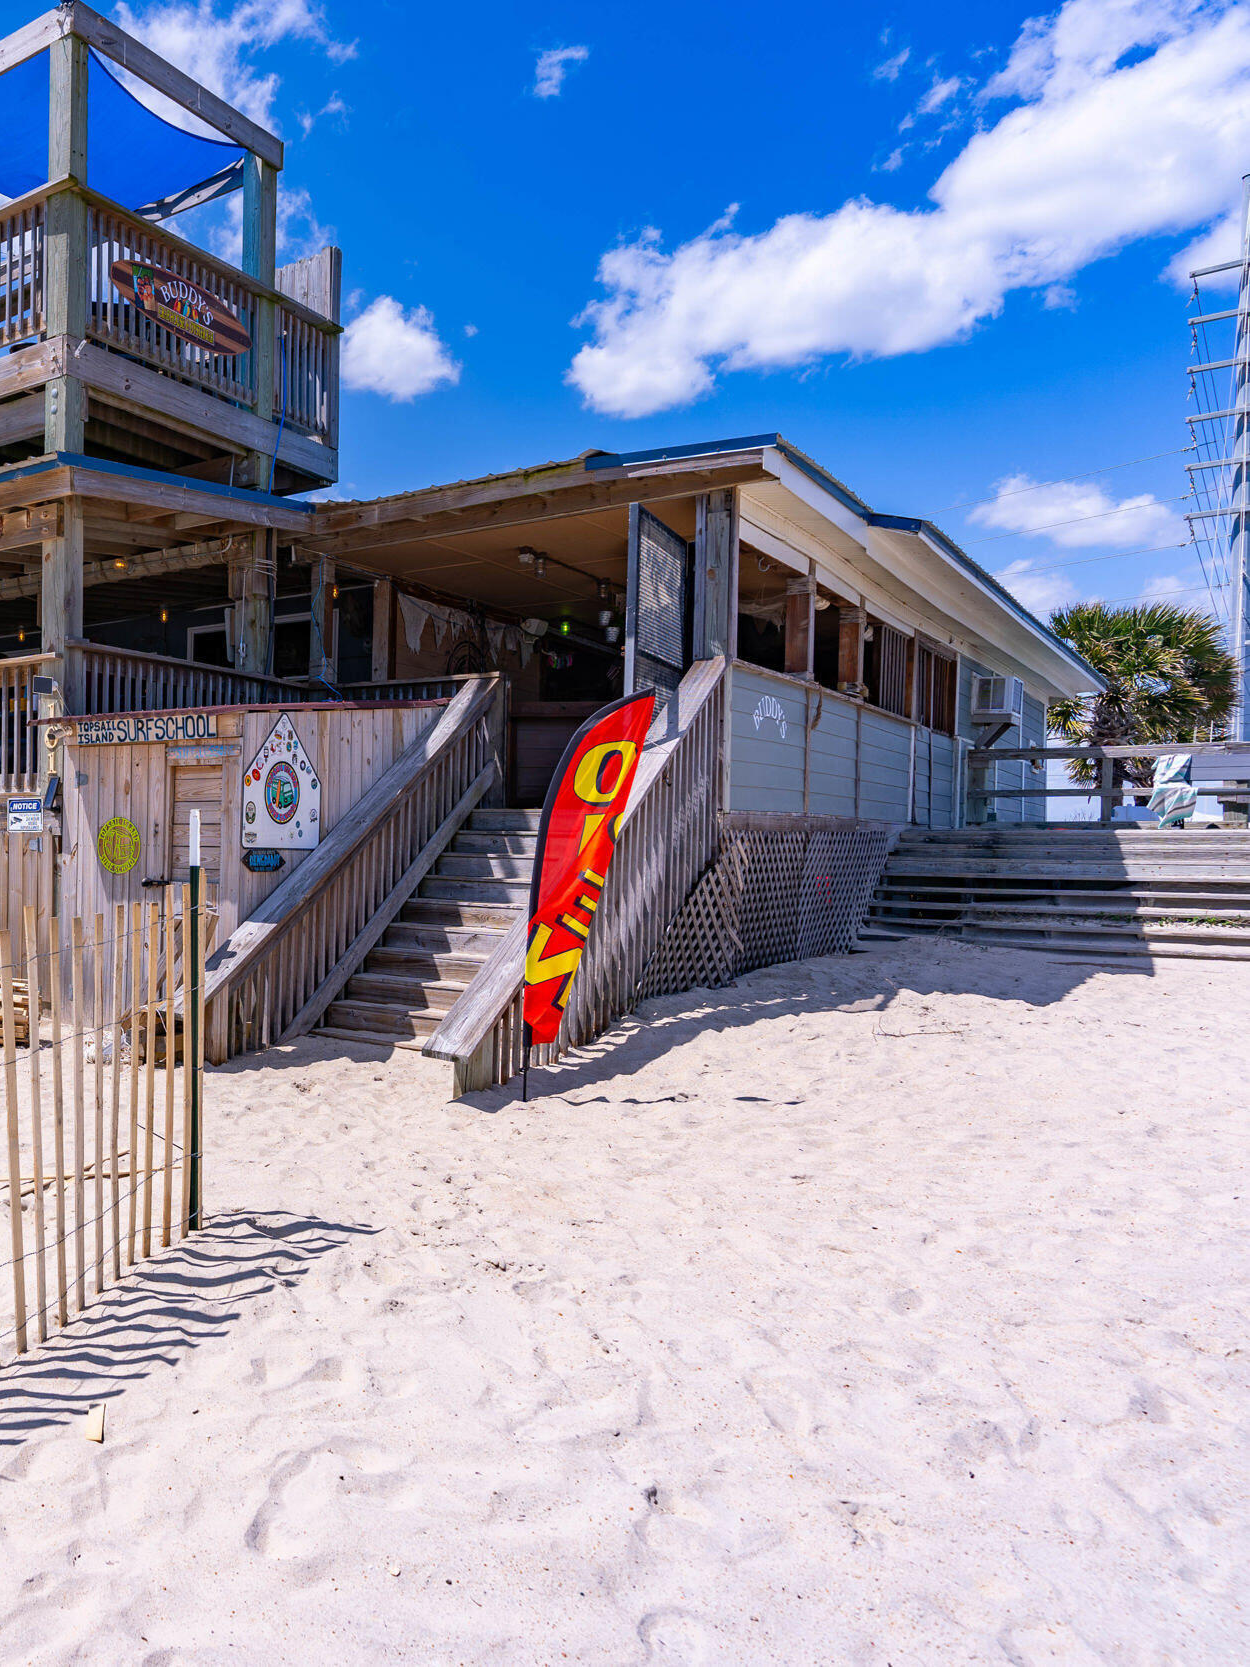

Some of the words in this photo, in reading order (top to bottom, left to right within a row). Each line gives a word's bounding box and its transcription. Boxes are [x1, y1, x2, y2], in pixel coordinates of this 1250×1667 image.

[160, 280, 214, 326] BUDDY'S
[753, 695, 788, 739] BUDDY'S
[77, 721, 117, 732] TOPSAIL
[78, 731, 115, 744] ISLAND
[12, 802, 38, 810] NOTICE
[98, 818, 122, 840] TOPSAIL
[121, 818, 139, 841] ISLAND
[113, 856, 138, 873] SCHOOL
